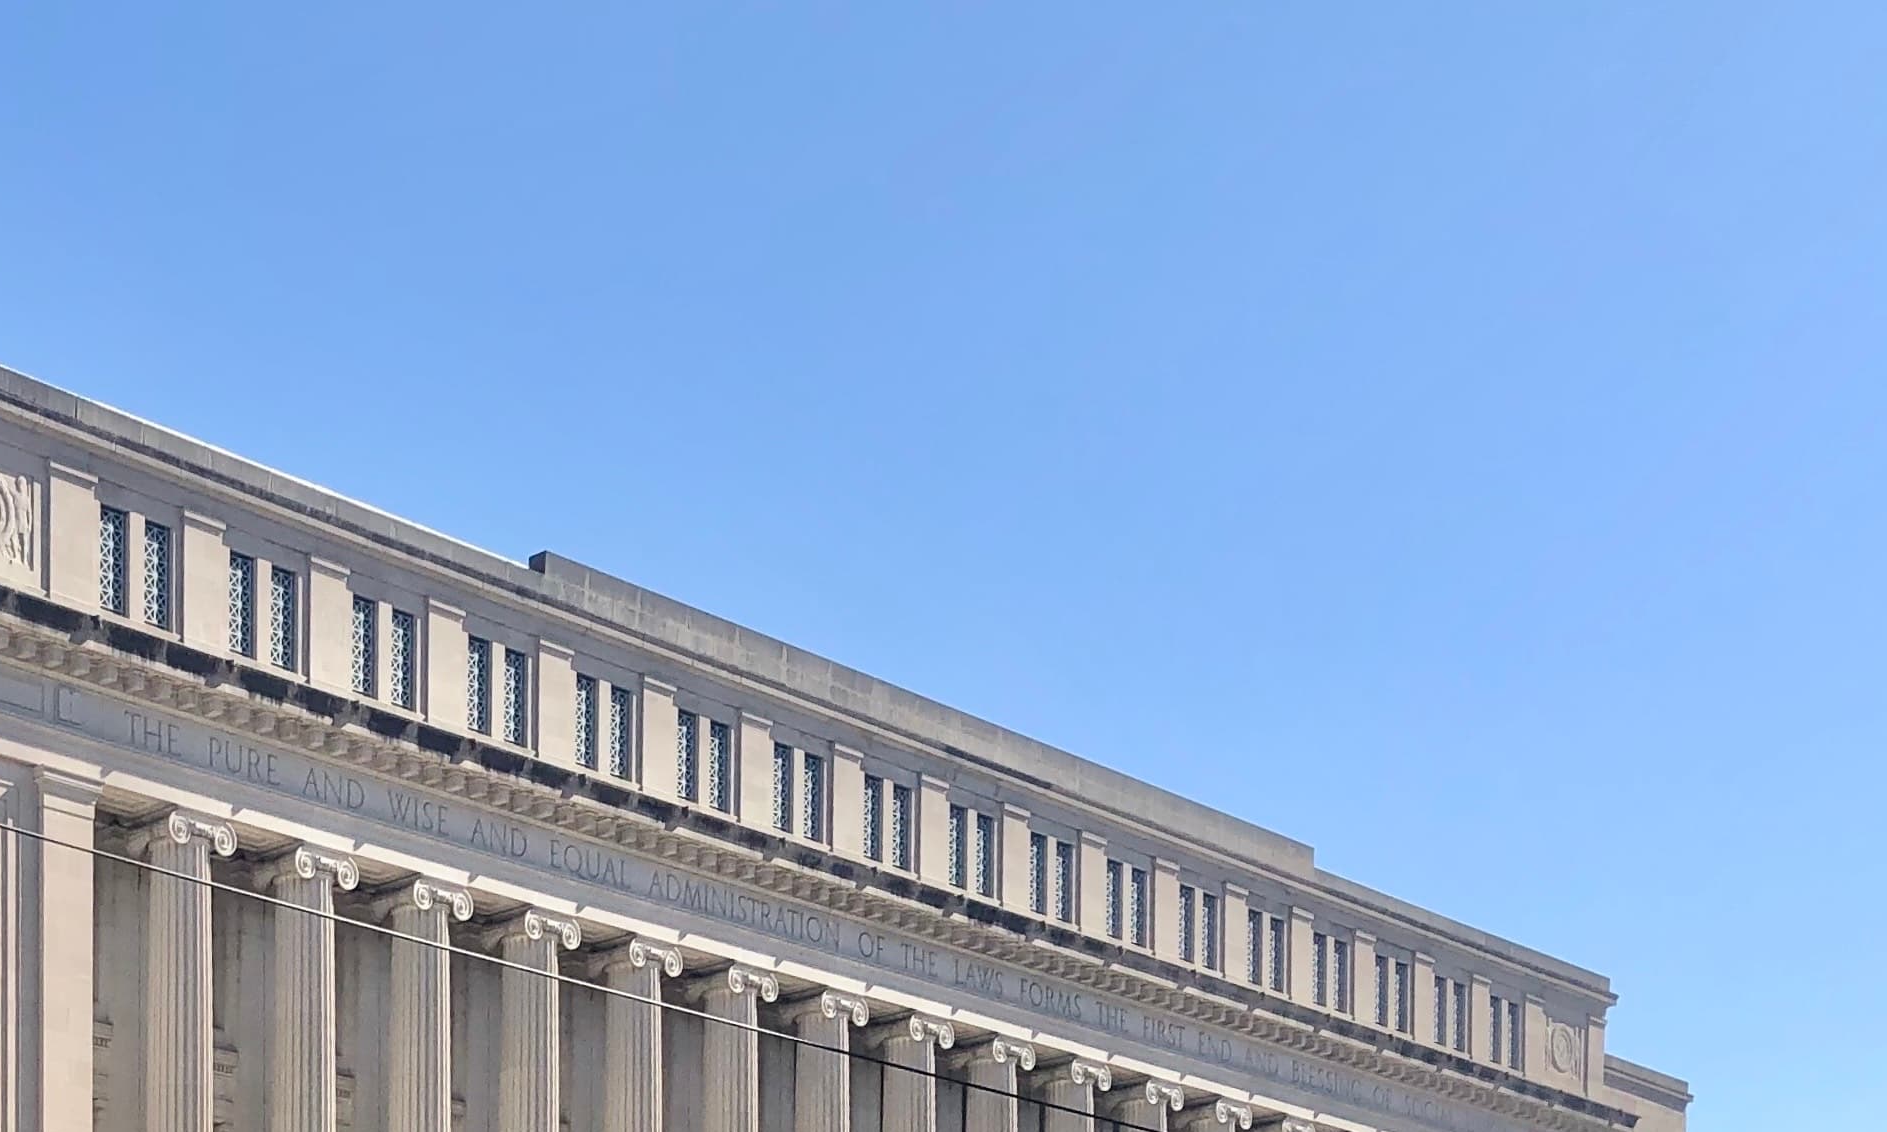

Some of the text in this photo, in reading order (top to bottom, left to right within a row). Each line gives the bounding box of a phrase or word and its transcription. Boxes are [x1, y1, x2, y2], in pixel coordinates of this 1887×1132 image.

[124, 710, 181, 757] THE
[209, 736, 281, 787] PURE
[302, 767, 364, 810] AND
[387, 788, 450, 838] WISE
[470, 818, 527, 858] AND
[550, 839, 632, 890] EQUAL
[648, 869, 841, 951] ADMINISTRATION
[858, 931, 885, 959] OF
[900, 943, 938, 978] THE
[954, 958, 1004, 999] LAWS
[1020, 978, 1081, 1020] FORMS
[1096, 1001, 1129, 1033] THE
[1143, 1015, 1185, 1050] FIRST
[1198, 1031, 1232, 1065] END
